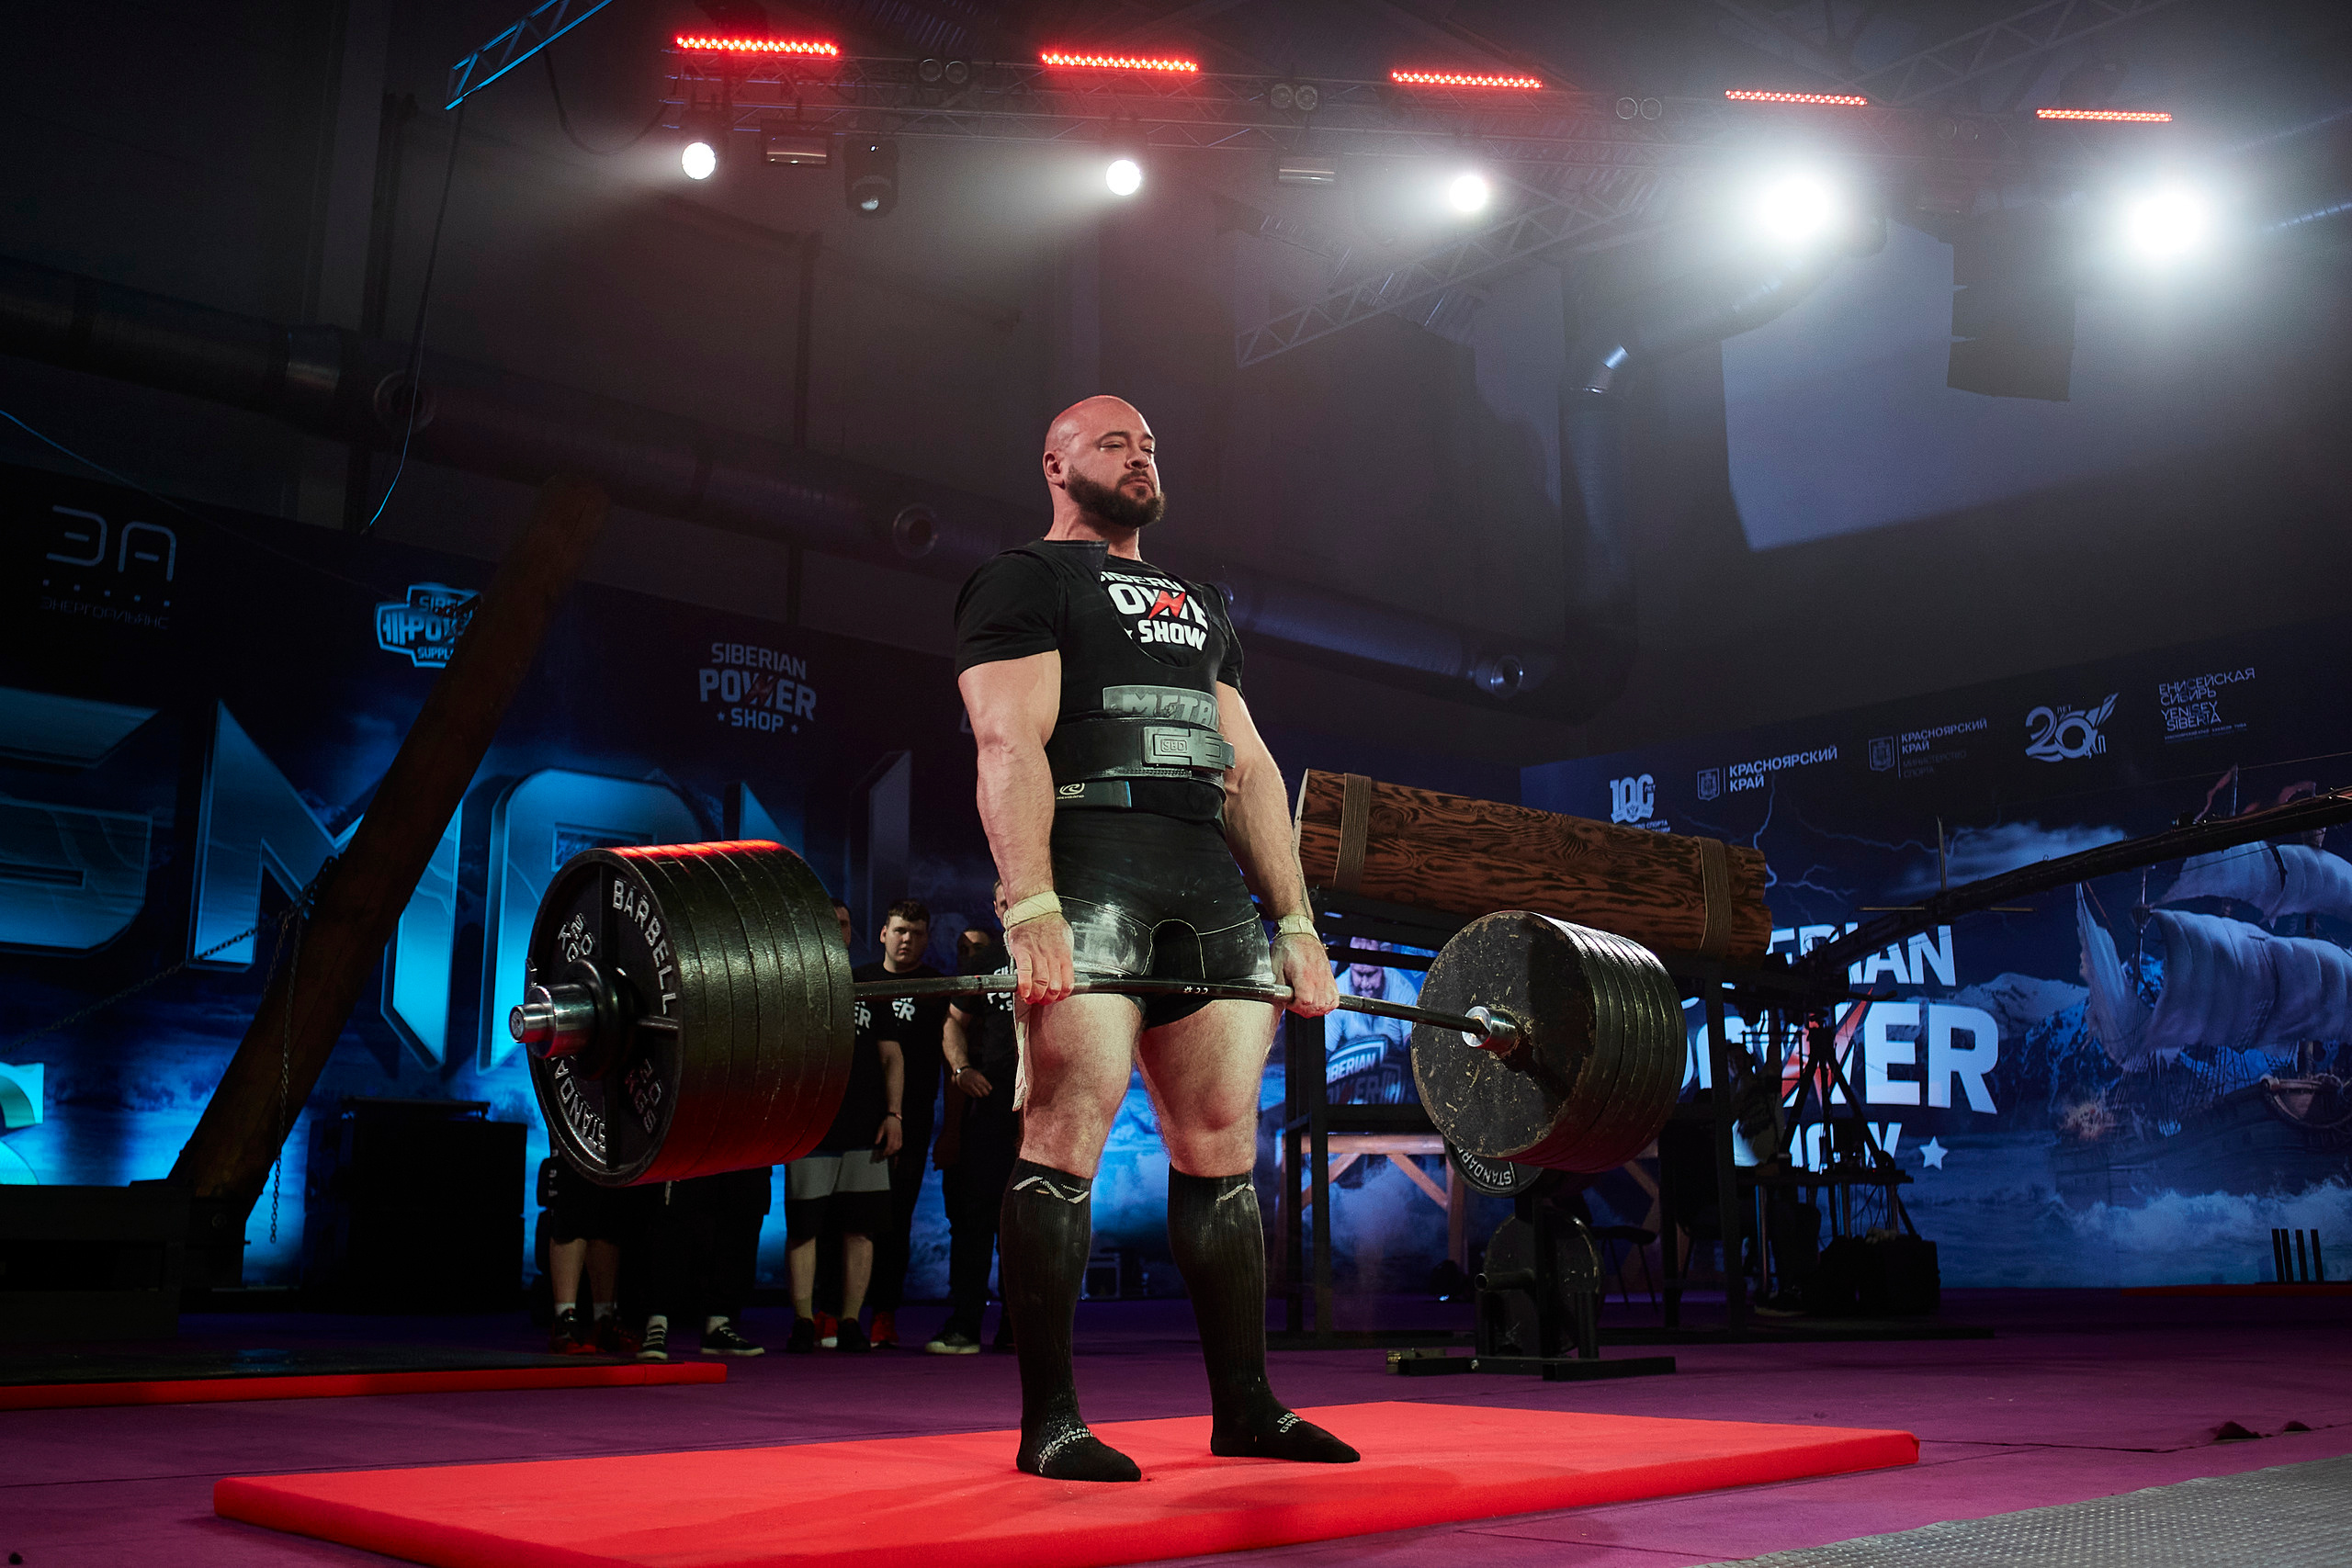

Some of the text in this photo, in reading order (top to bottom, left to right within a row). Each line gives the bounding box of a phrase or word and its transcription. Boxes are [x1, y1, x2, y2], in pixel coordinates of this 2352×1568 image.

[1137, 619, 1207, 651] SHOW
[711, 642, 807, 681] SIBERIAN
[699, 668, 817, 722] POWER
[2158, 667, 2256, 696] ЕНИСЕЙСКАЯ
[2160, 687, 2217, 706] СИБИРЬ
[2161, 700, 2218, 721] YENISEY
[730, 707, 784, 733] SHOP
[1901, 716, 1988, 744] КРАСНОЯРСКИЙ
[2166, 712, 2222, 732] SIBERIA
[1162, 740, 1186, 752] SBD
[1902, 740, 1930, 755] КРАЙ
[1728, 745, 1838, 778] КРАСНОЯРСКИЙ
[1729, 774, 1765, 793] КРАЙ
[611, 876, 678, 1016] BARBELL
[1325, 1051, 1377, 1085] IBERIAN
